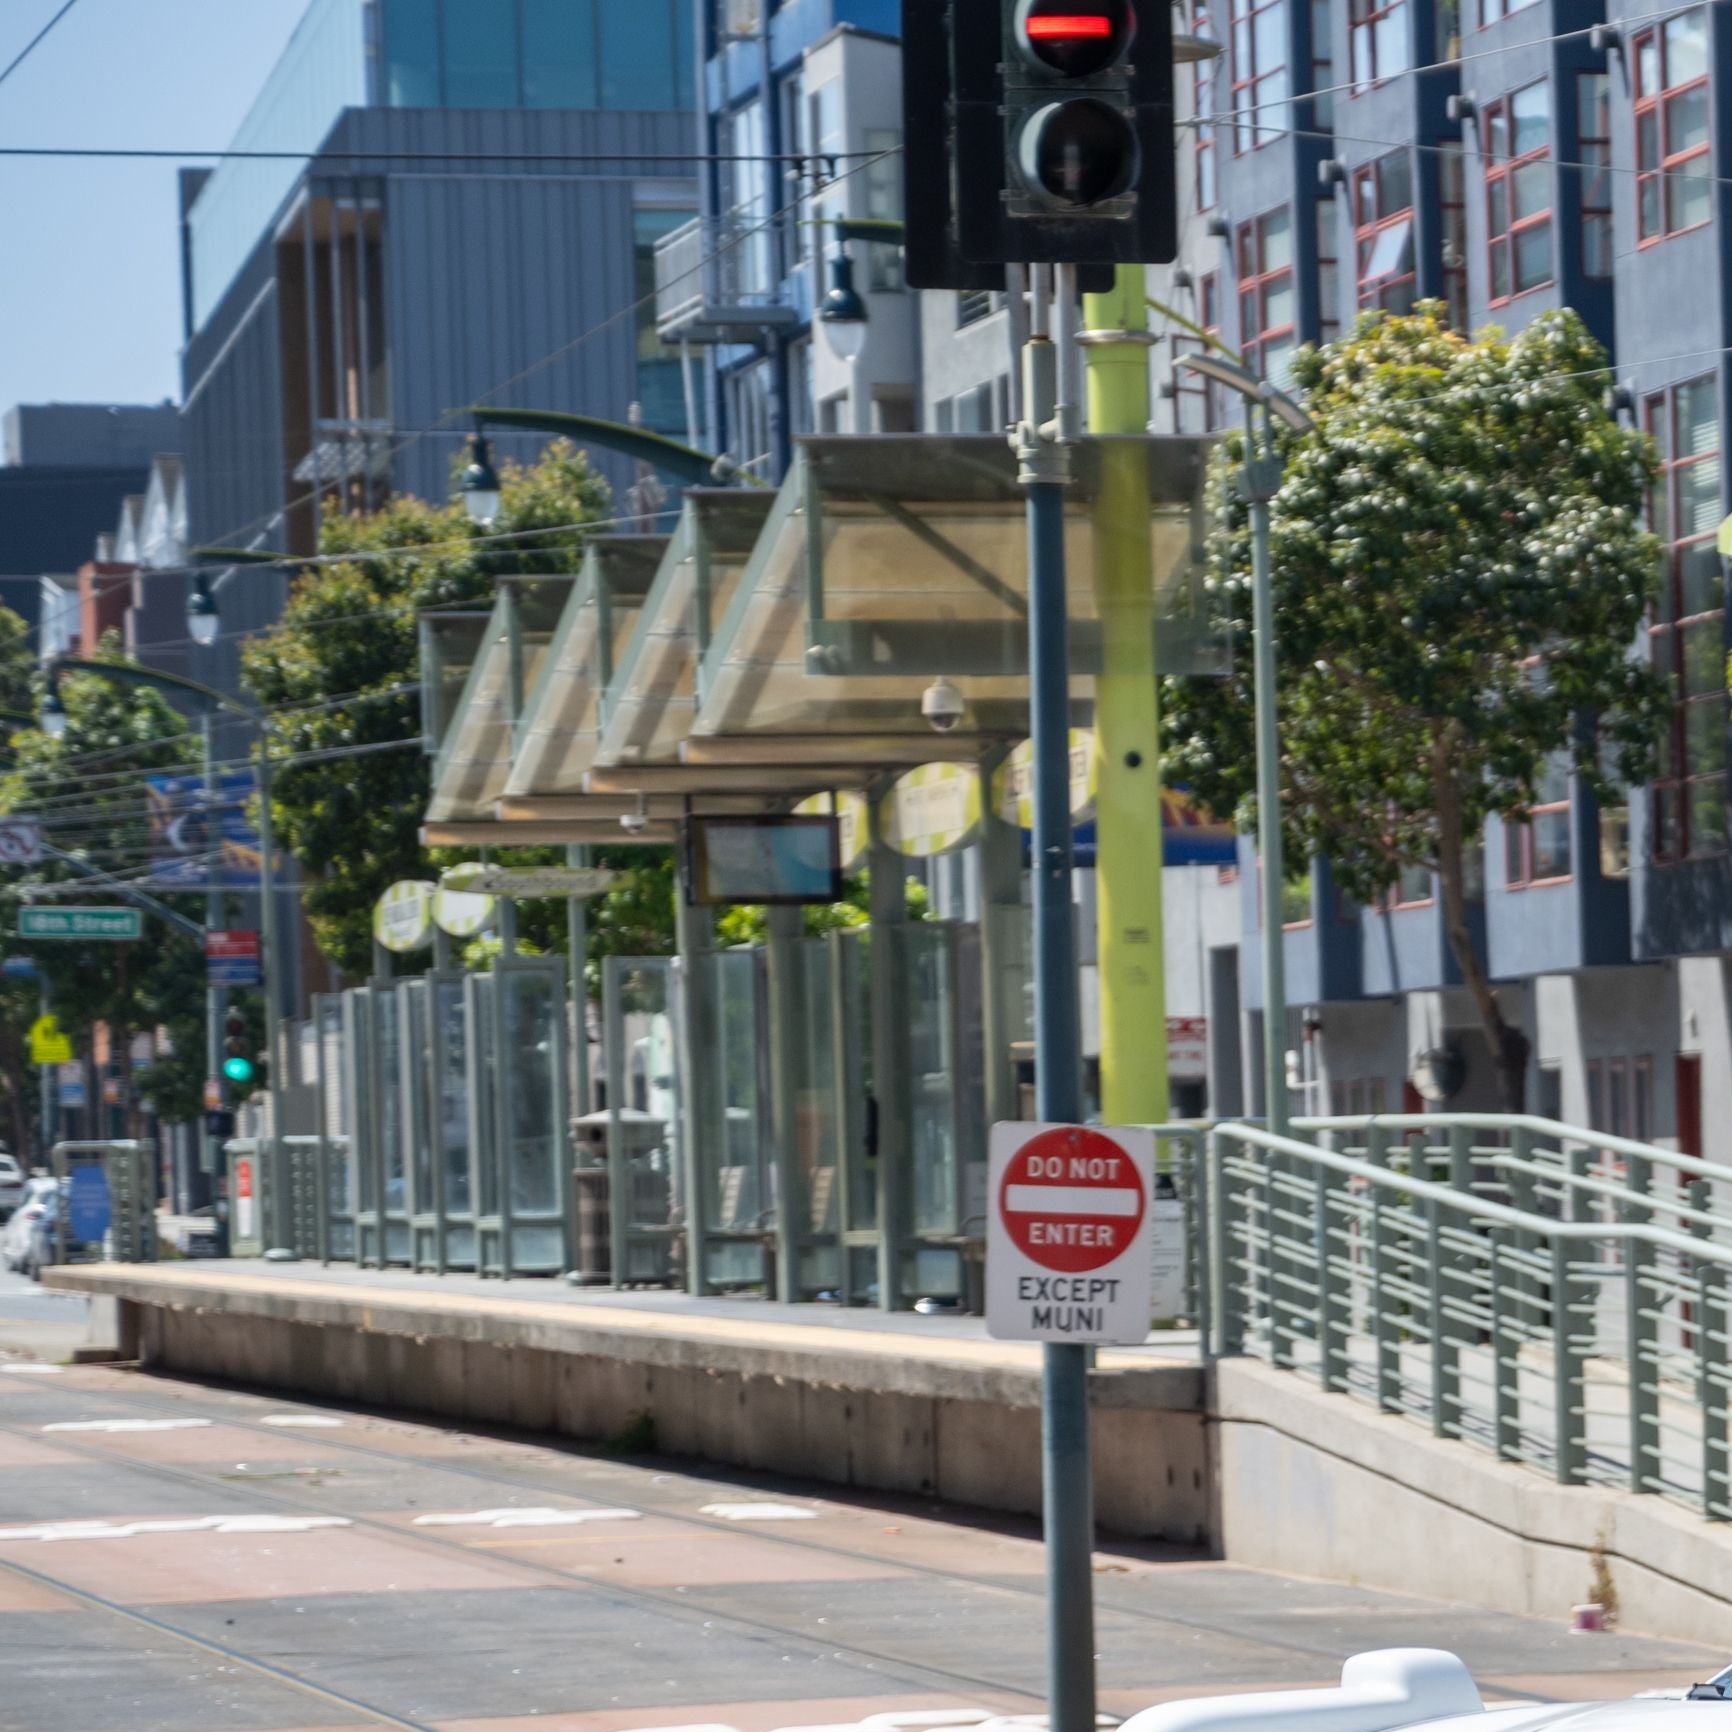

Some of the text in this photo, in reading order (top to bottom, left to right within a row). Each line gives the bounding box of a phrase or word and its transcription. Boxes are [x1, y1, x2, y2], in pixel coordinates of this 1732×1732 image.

[1027, 1156, 1120, 1180] DO NOT
[1029, 1222, 1114, 1246] ENTER
[1018, 1276, 1120, 1303] EXCEPT
[1031, 1306, 1103, 1332] MUNI
